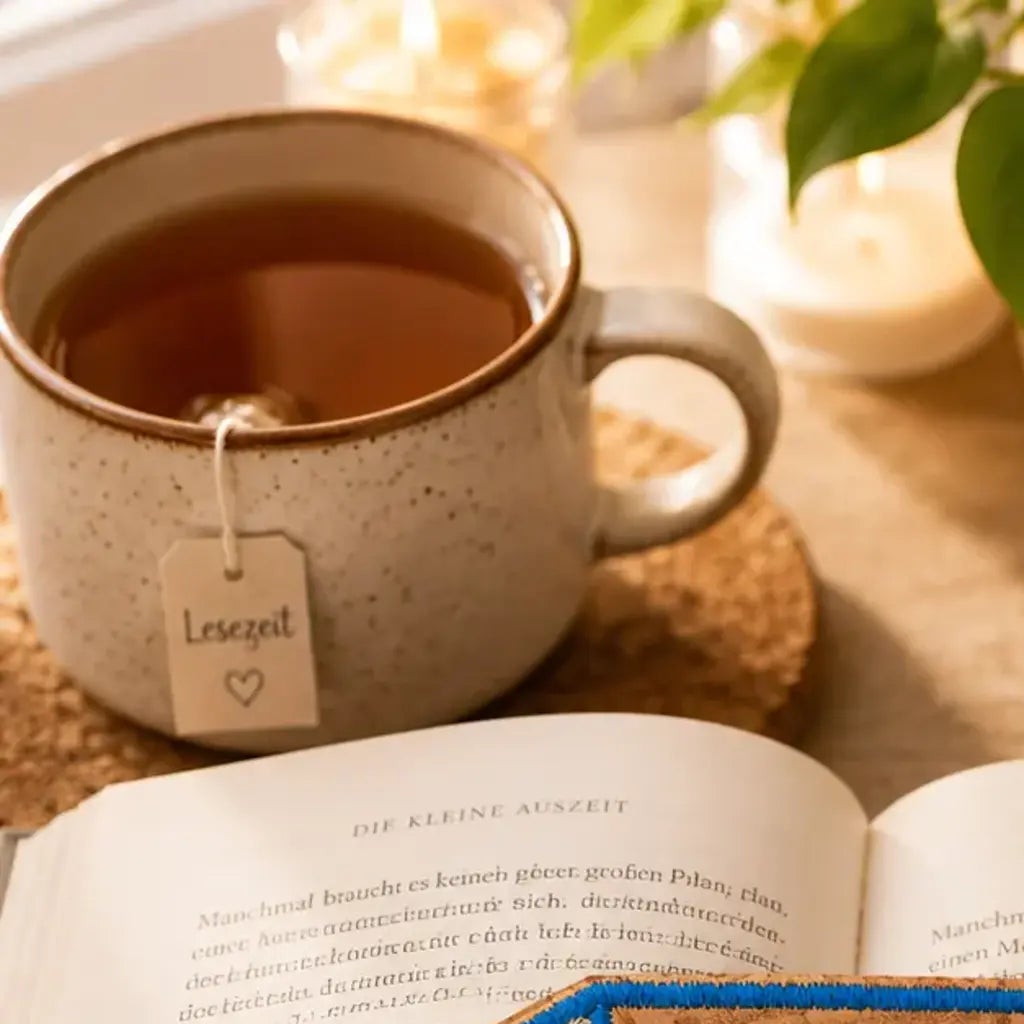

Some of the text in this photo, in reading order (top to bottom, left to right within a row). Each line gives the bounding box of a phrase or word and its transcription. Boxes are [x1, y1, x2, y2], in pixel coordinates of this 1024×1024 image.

[184, 604, 296, 651] Lesezeit
[352, 799, 629, 837] DIE KLEINE AUSZEIT
[197, 893, 314, 930] Manchmal
[408, 877, 430, 893] es
[928, 947, 988, 973] einen
